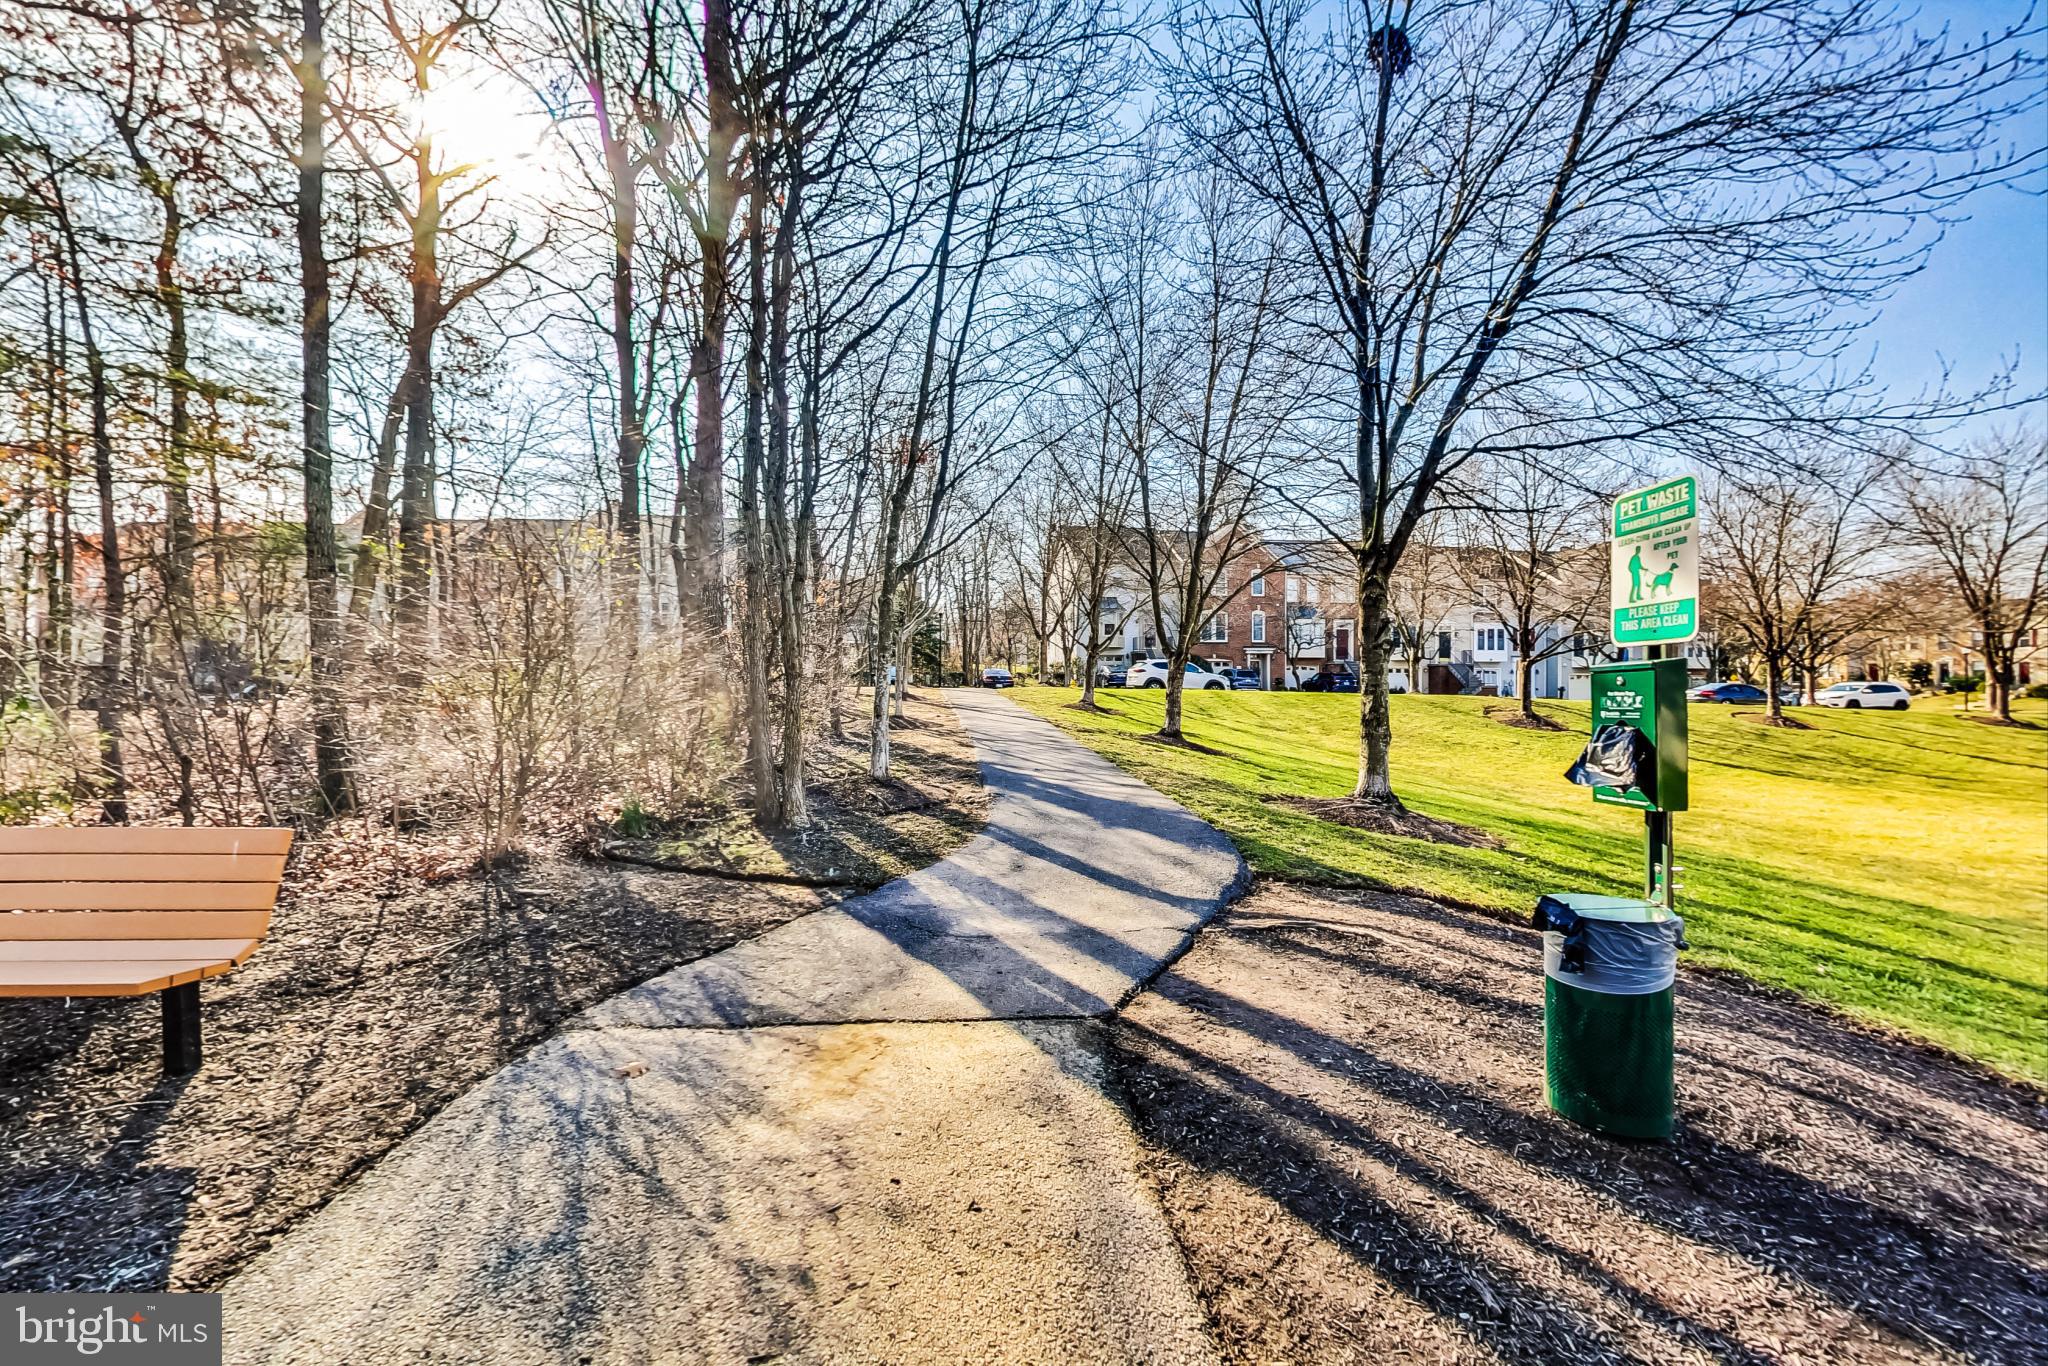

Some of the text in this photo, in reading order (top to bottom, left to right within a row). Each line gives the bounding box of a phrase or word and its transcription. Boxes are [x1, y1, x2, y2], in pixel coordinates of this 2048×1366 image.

[1620, 483, 1690, 518] PET WASTE
[1652, 529, 1663, 540] AND
[1664, 525, 1682, 536] CLEAN
[1667, 551, 1679, 560] PET
[1629, 602, 1680, 618] PLEASE KEEP
[1620, 614, 1689, 631] THIS AREA CLEAN
